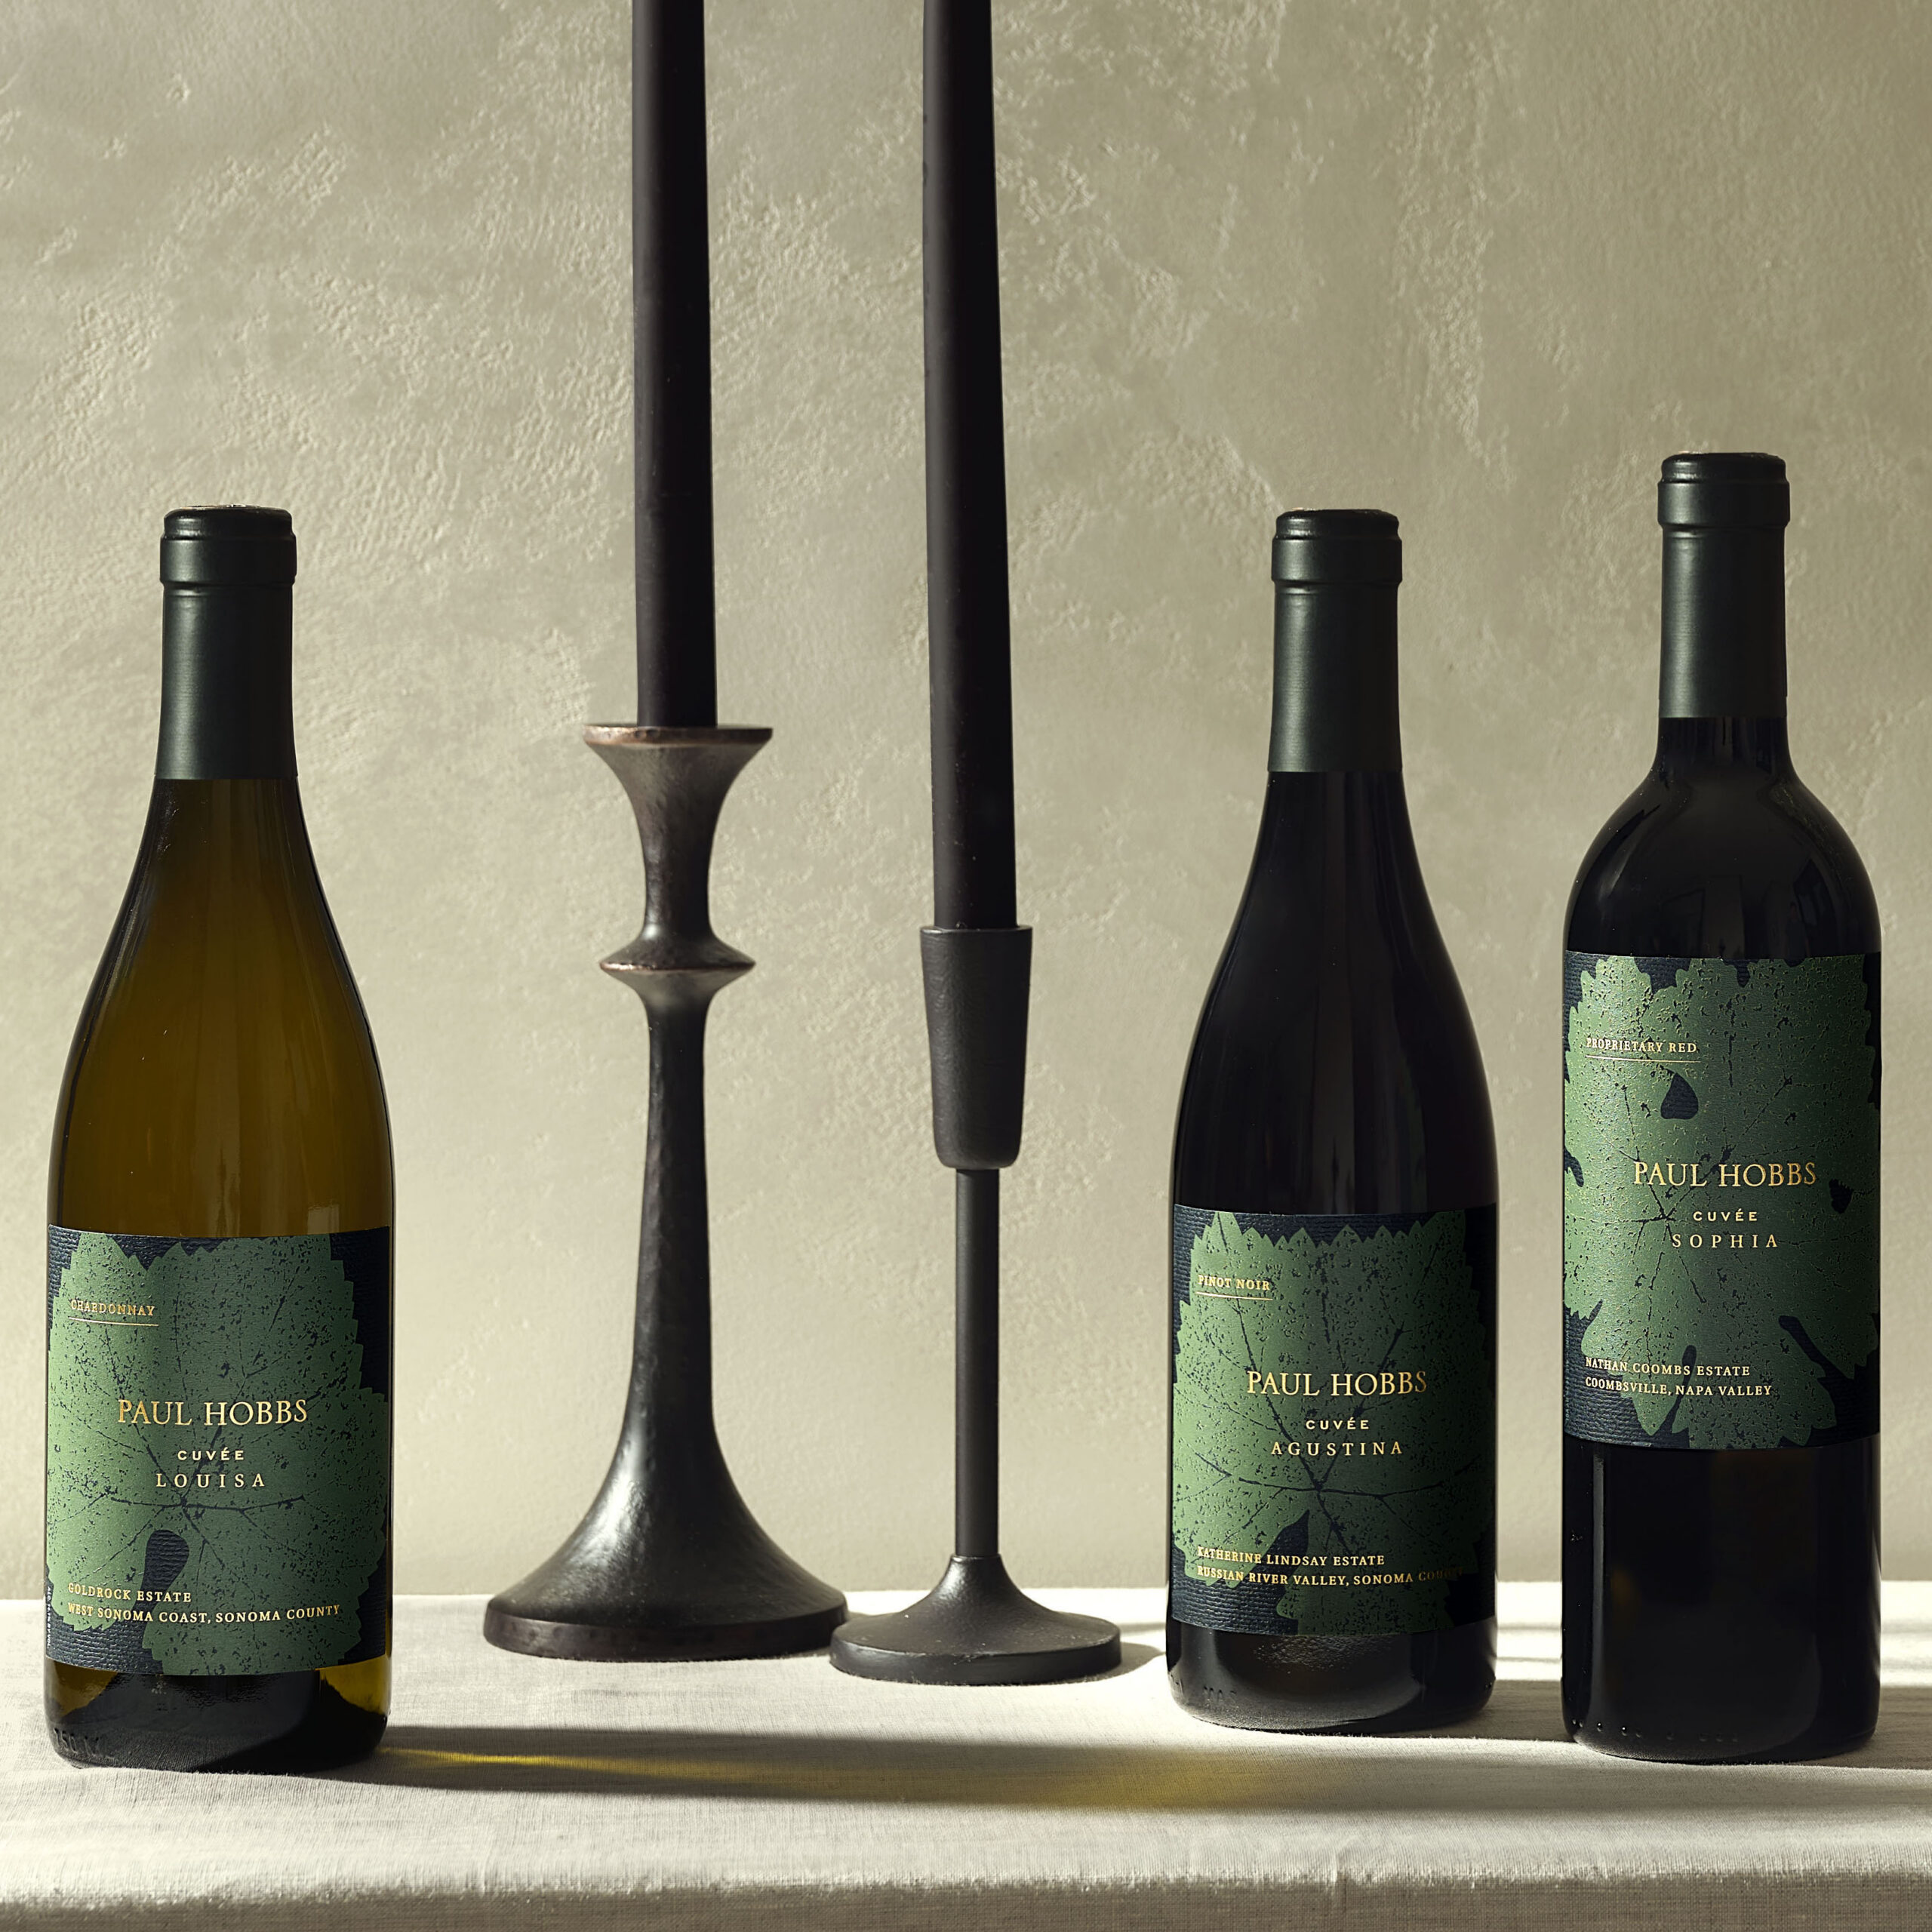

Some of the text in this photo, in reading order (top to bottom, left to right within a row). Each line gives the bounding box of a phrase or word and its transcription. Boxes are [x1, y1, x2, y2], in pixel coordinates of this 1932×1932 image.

[1586, 1038, 1697, 1053] PROPRIETARY RED
[1633, 1161, 1817, 1187] PAUL HOBBS
[1693, 1208, 1758, 1222] CUVÉE
[1672, 1234, 1777, 1248] SOPHIA
[1198, 1275, 1270, 1291] PINOT NOIR
[71, 1299, 155, 1316] CHARDONNAY
[1585, 1356, 1750, 1376] NATHAN COOMBS ESTATE
[1247, 1371, 1427, 1396] PAUL HOBBS
[1585, 1376, 1772, 1396] COOMBSVILLE, NAPA VALLEY
[118, 1399, 307, 1426] PAUL HOBBS
[1306, 1417, 1369, 1430] CUVÉE
[177, 1447, 244, 1461] CUVÉE
[1271, 1441, 1402, 1457] AGUSTINA
[156, 1473, 265, 1488] LOUISA
[1197, 1546, 1385, 1566] KATHERINE LINDSAY ESTATE
[1197, 1565, 1244, 1581] RUSSIAN
[1249, 1572, 1287, 1584] RIVER
[1294, 1575, 1349, 1587] VALLEY,
[1353, 1573, 1414, 1585] SONOMA
[68, 1583, 192, 1602] GOLDROCK ESTATE
[68, 1602, 340, 1624] WEST SONOMA COAST, SONOMA COUNTY
